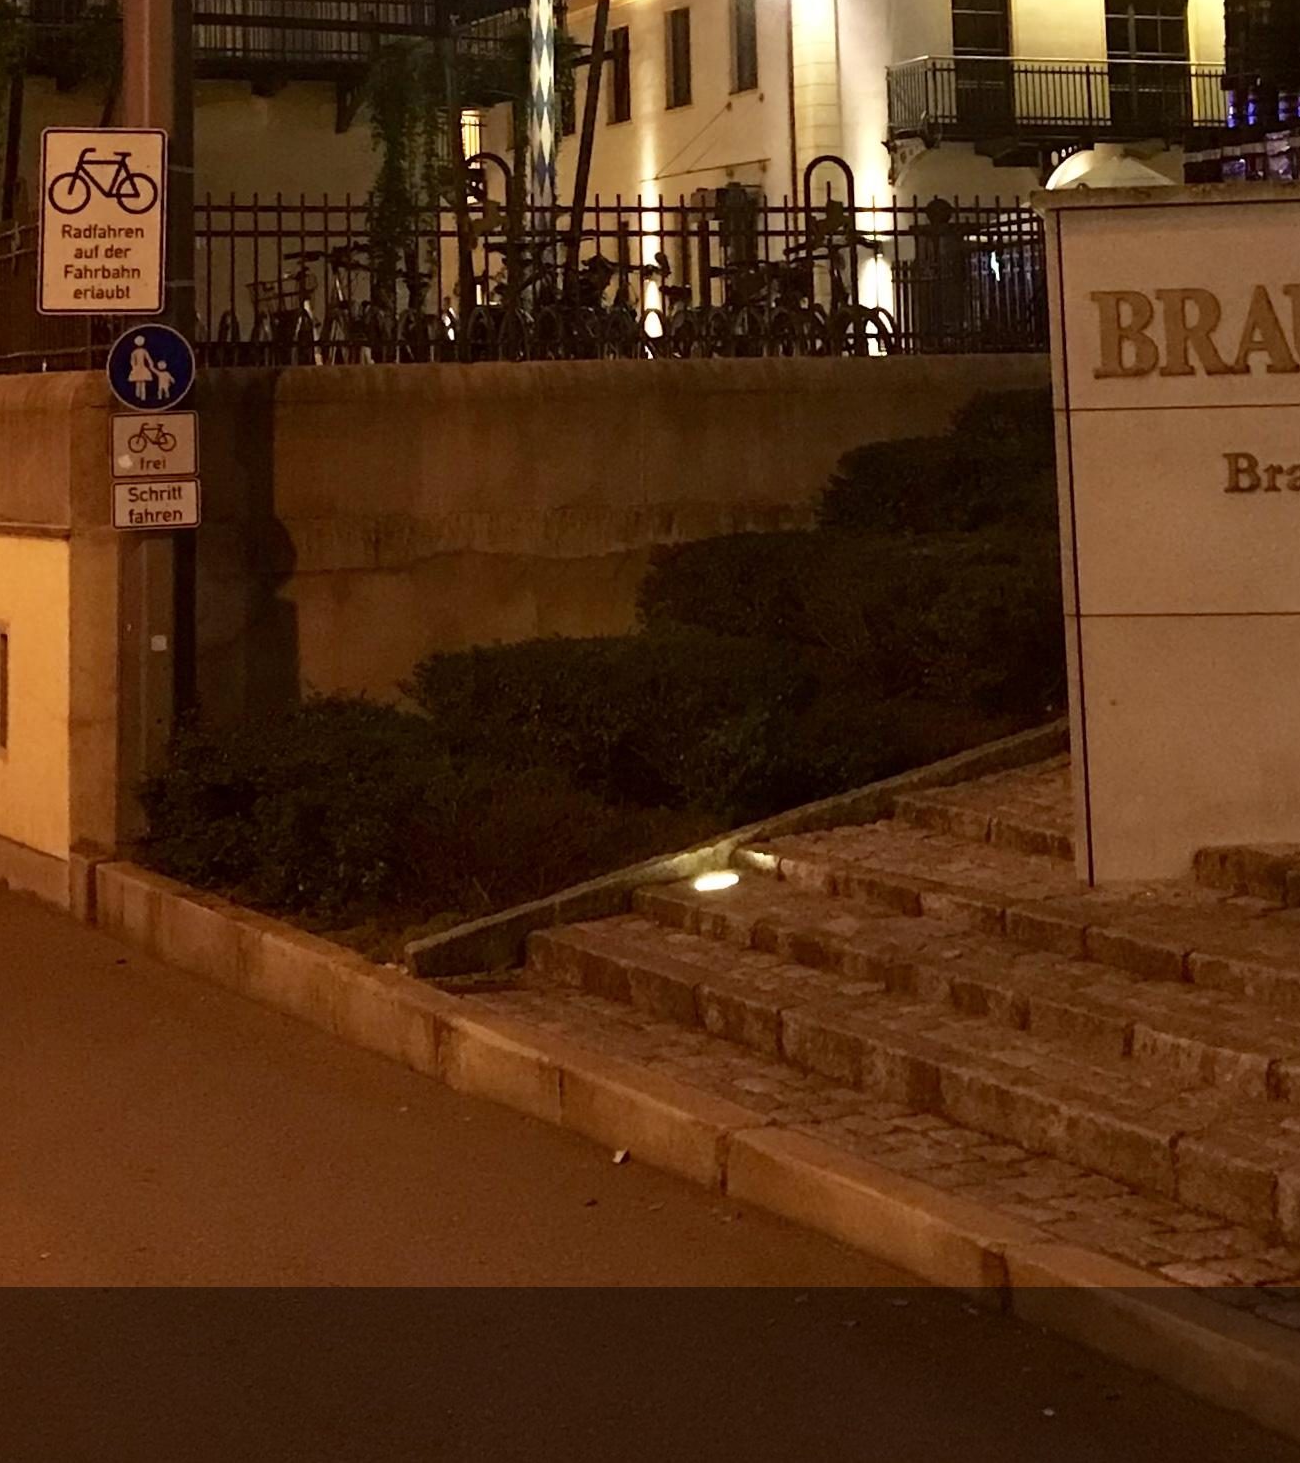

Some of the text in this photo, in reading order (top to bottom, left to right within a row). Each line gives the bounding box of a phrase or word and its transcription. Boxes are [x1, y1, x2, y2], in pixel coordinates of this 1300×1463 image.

[61, 224, 144, 239] Radfahren
[74, 244, 131, 259] auf der
[63, 264, 141, 279] Fahrbahn
[73, 285, 131, 300] erlaubt
[139, 457, 167, 470] frei
[127, 486, 183, 503] Schritt
[128, 508, 183, 524] fahren
